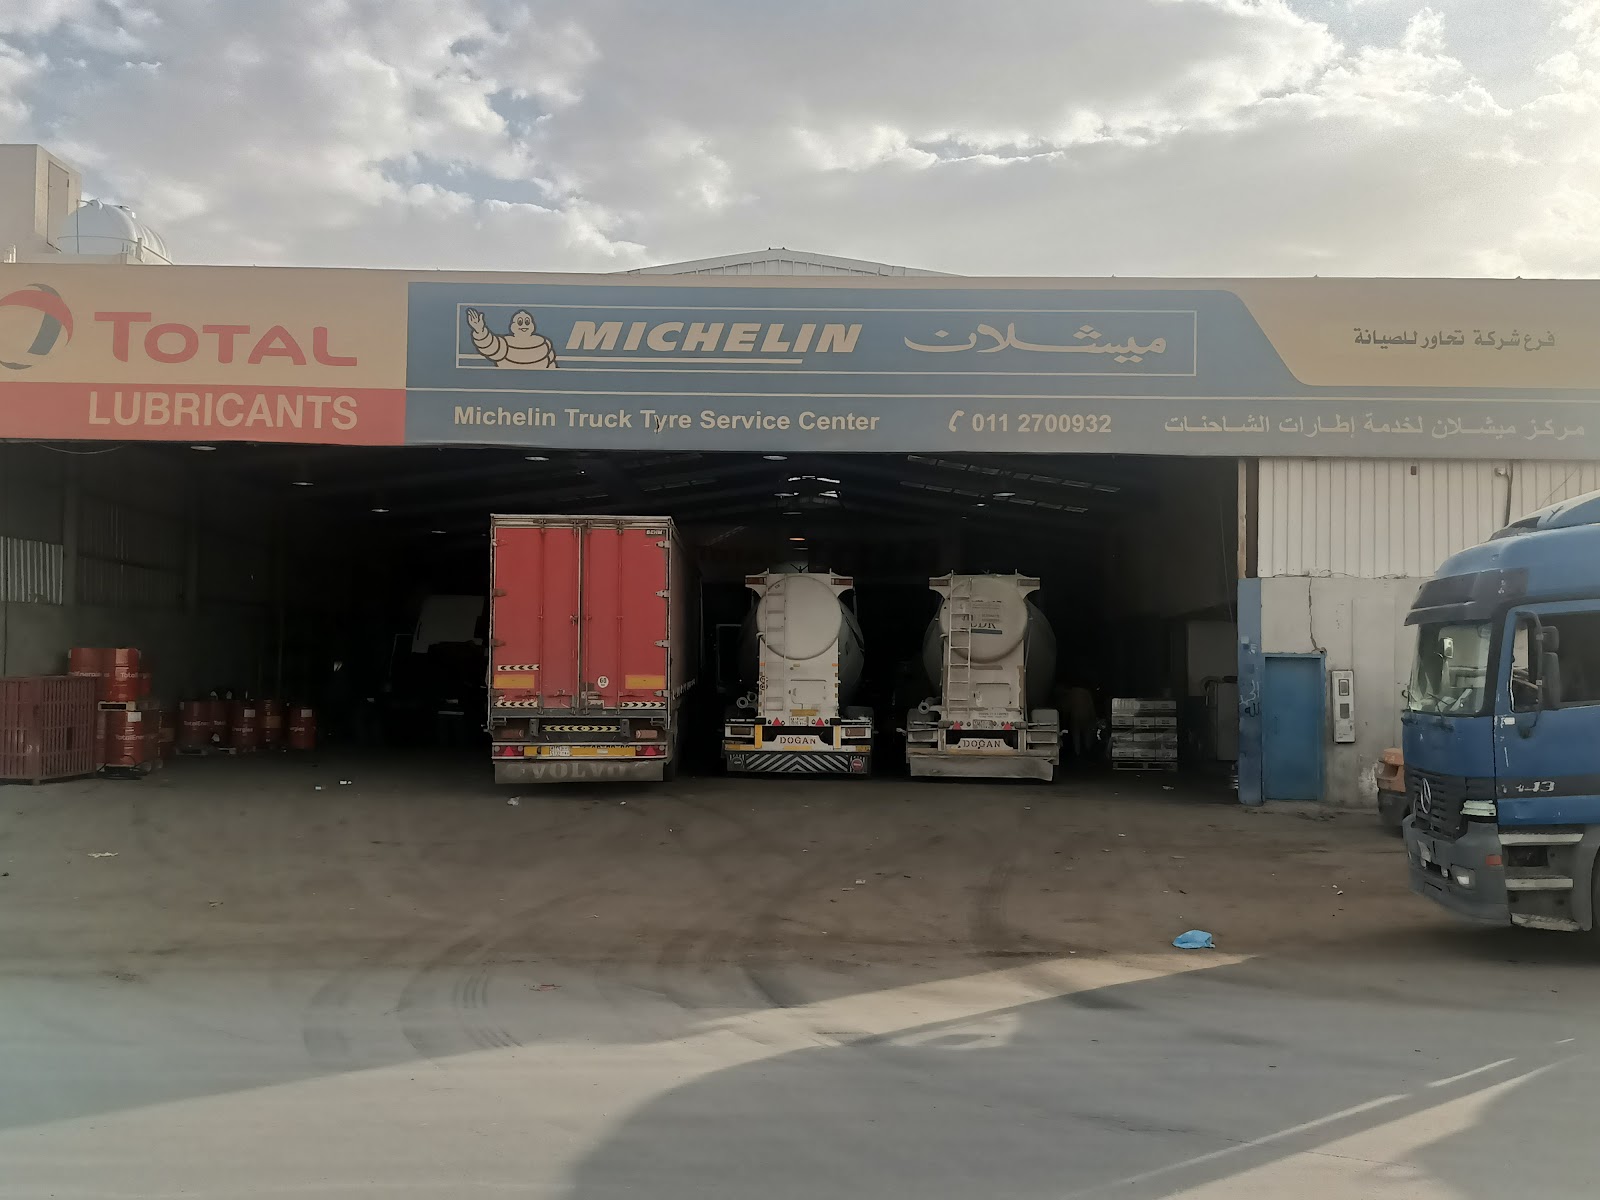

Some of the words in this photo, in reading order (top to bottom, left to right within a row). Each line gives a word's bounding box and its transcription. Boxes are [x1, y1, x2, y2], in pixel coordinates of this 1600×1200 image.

[94, 311, 358, 367] TOTAL
[565, 320, 863, 353] MICHELIN
[903, 322, 1167, 364] ميشلان
[1353, 327, 1419, 351] للصيانة
[1473, 328, 1521, 351] شركة
[1524, 330, 1556, 351] فرع
[89, 391, 358, 431] LUBRICANTS
[453, 405, 556, 428] Michelin
[564, 407, 632, 429] Truck
[640, 409, 692, 434] Tyre
[699, 409, 790, 431] Service
[797, 411, 880, 432] Center
[971, 413, 1008, 433] 011
[1017, 413, 1112, 434] 2700932
[1163, 415, 1270, 435] الشاحنات
[1278, 413, 1356, 439] إطارات
[1363, 413, 1424, 436] لخدمة
[1431, 415, 1516, 440] ميشلان
[1525, 419, 1586, 442] مركز
[779, 736, 817, 745] DOGAN
[962, 739, 1001, 748] DOGAN
